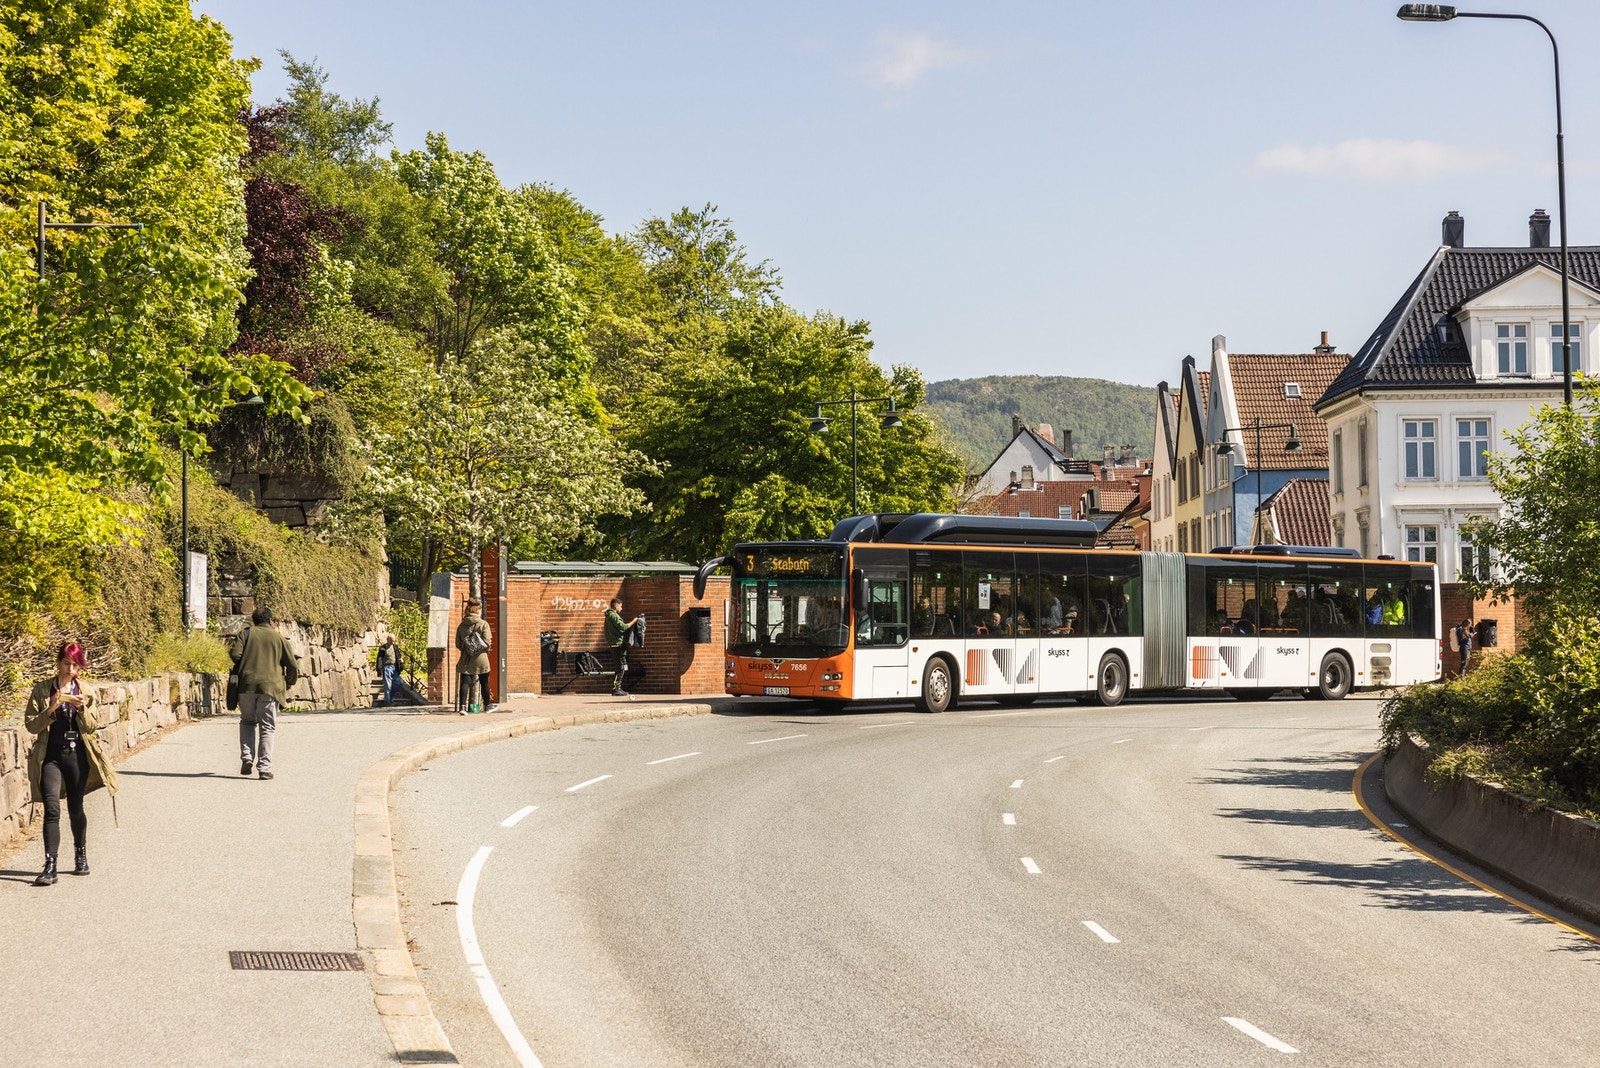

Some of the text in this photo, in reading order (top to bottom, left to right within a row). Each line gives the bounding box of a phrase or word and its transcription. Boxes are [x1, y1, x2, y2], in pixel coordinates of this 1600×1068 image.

[746, 555, 754, 571] 3
[1048, 647, 1065, 658] skyss
[1276, 646, 1295, 656] skyss
[748, 661, 773, 672] skyss
[791, 663, 807, 671] 7656
